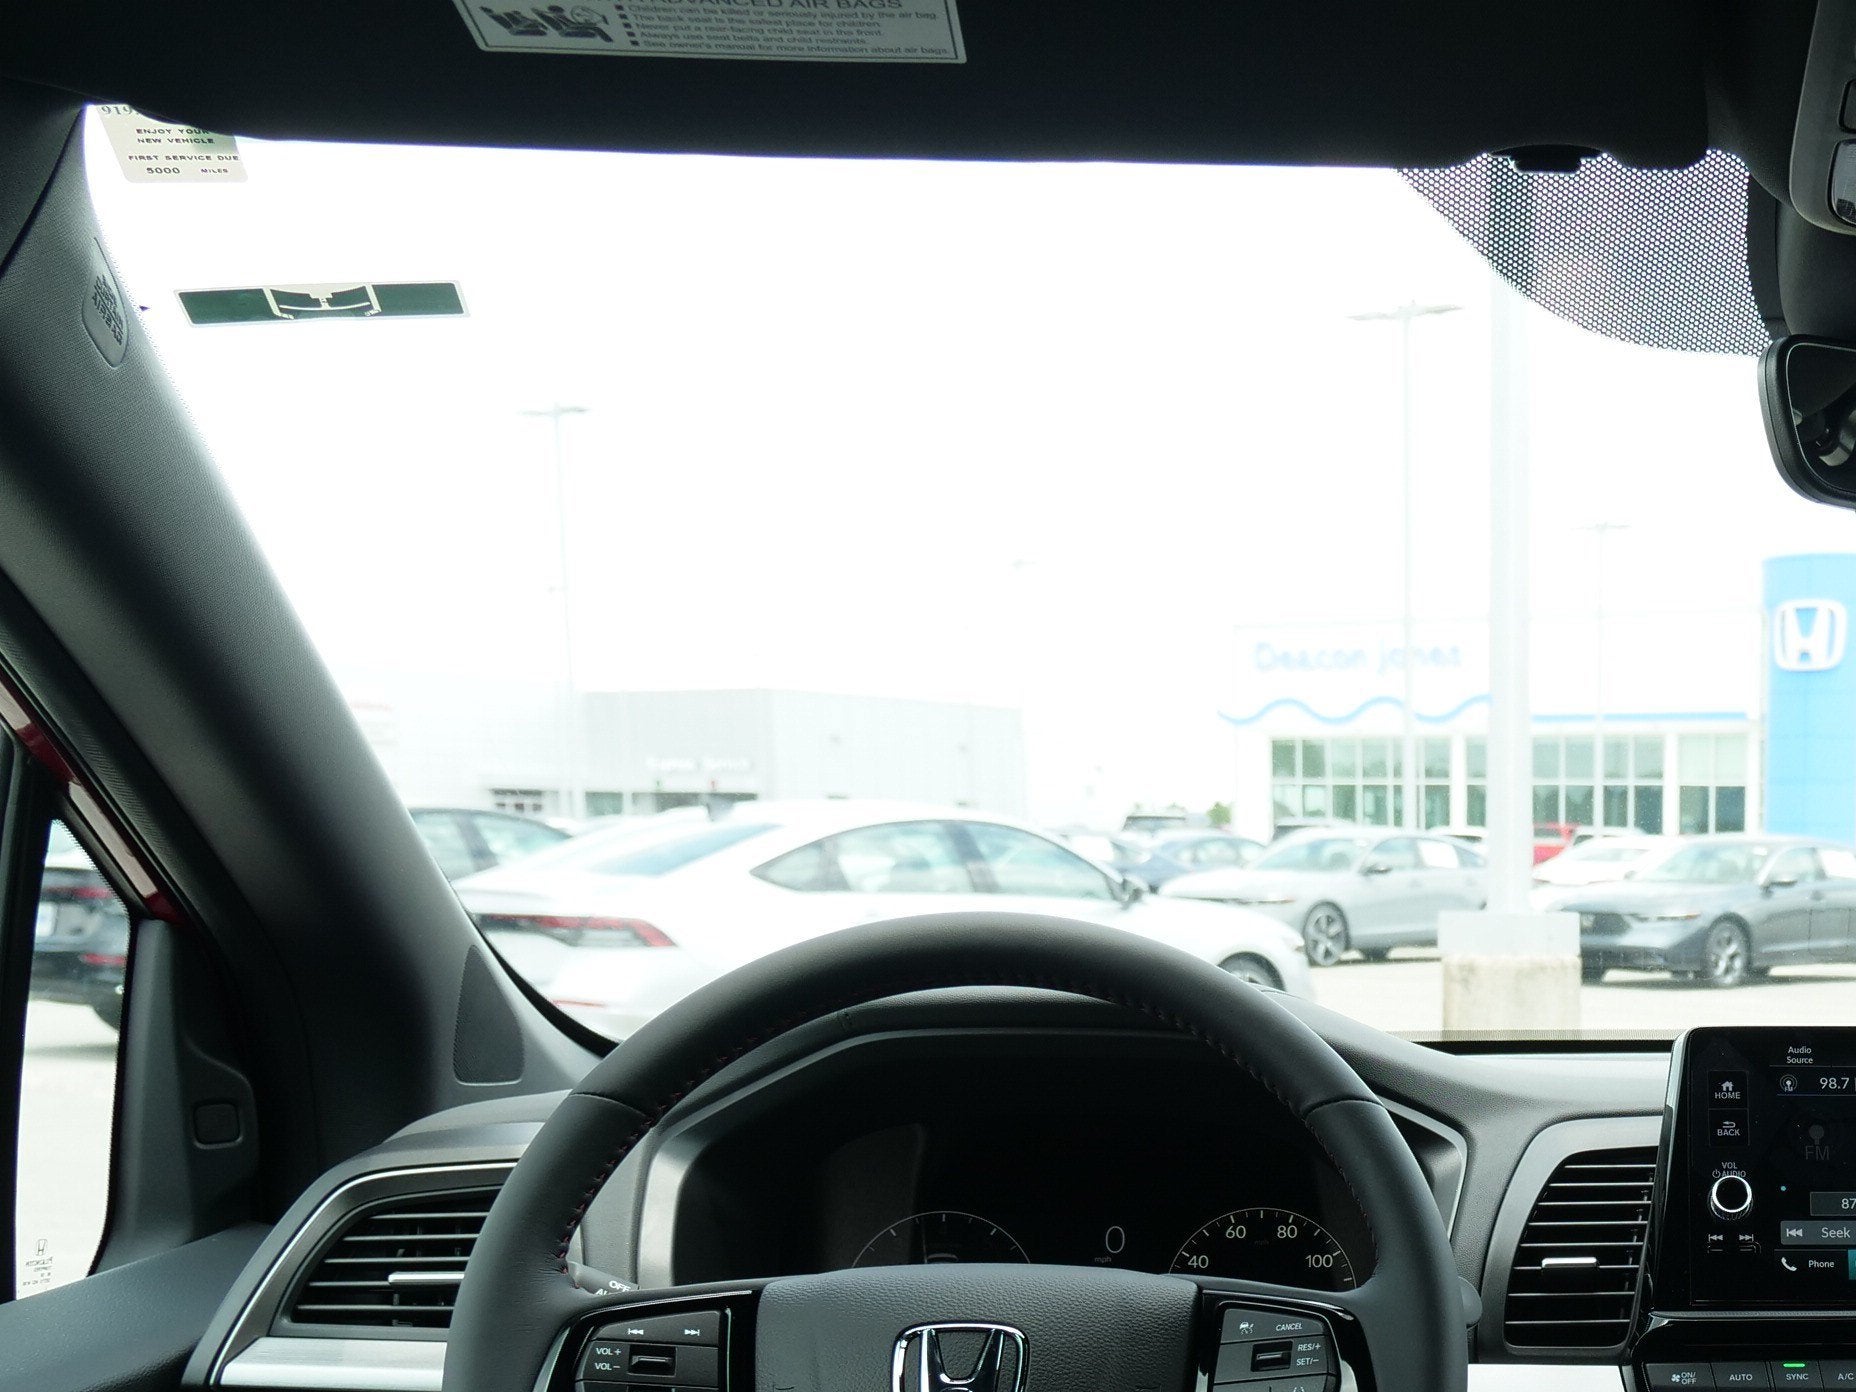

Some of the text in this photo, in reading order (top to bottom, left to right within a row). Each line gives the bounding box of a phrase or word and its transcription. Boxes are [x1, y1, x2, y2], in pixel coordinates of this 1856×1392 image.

[1788, 1046, 1812, 1054] Audio
[1786, 1056, 1814, 1064] Source
[1819, 1077, 1850, 1089] 98.7
[1714, 1091, 1741, 1099] HOME
[1717, 1129, 1741, 1137] BACK
[1805, 1145, 1830, 1161] FM
[1721, 1162, 1738, 1170] VOL
[1721, 1170, 1747, 1178] AUDIO
[1225, 1225, 1247, 1239] 60
[1276, 1225, 1298, 1239] 80
[1821, 1227, 1851, 1238] Seek
[1105, 1225, 1126, 1254] 0
[1187, 1254, 1209, 1269] 40
[1305, 1254, 1334, 1268] 100
[1808, 1259, 1835, 1268] Phone
[609, 1280, 631, 1292] OFF
[1276, 1323, 1303, 1331] CANCEL
[1297, 1343, 1321, 1351] RES/+
[1729, 1374, 1753, 1382] AUTO
[1785, 1373, 1809, 1381] SYNC
[1837, 1372, 1855, 1381] A/C
